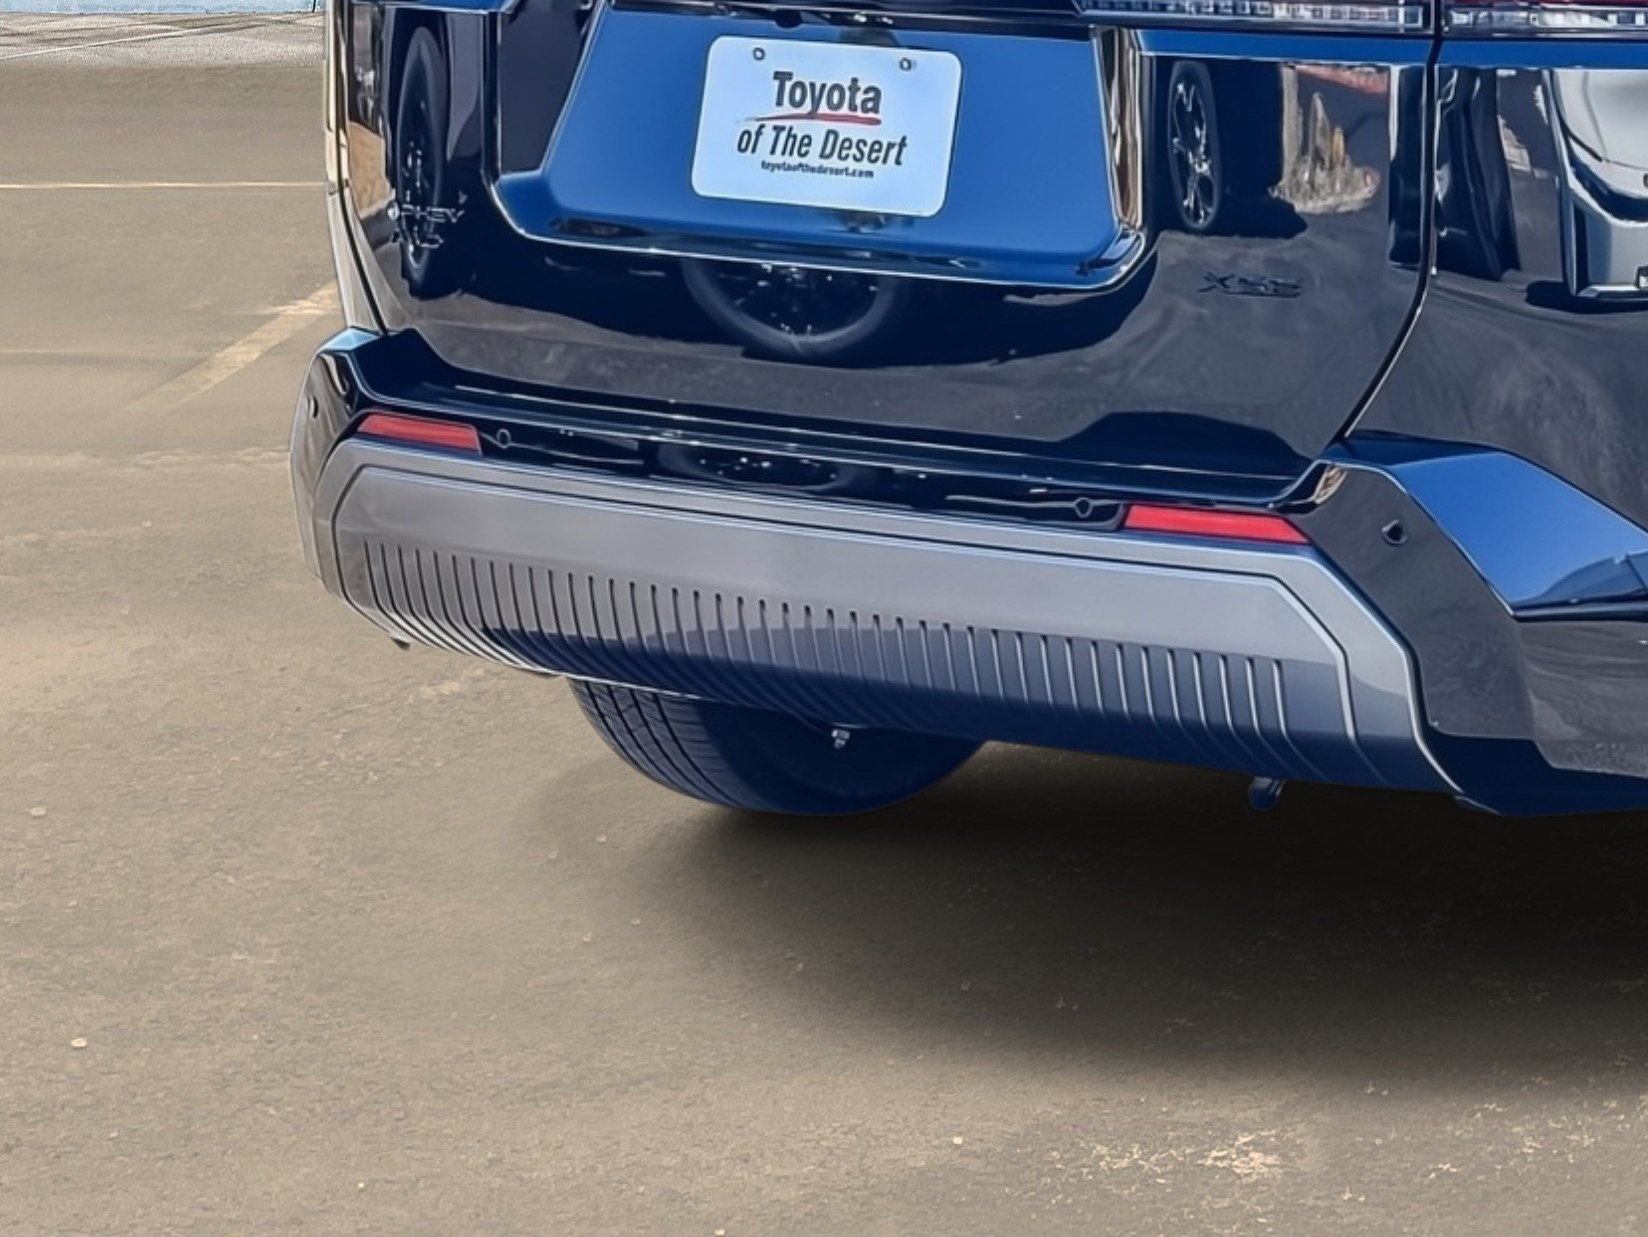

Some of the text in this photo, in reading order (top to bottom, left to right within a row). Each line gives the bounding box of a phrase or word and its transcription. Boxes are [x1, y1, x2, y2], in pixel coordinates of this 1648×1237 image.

[773, 70, 882, 117] Toyota
[737, 123, 908, 166] of The Desert
